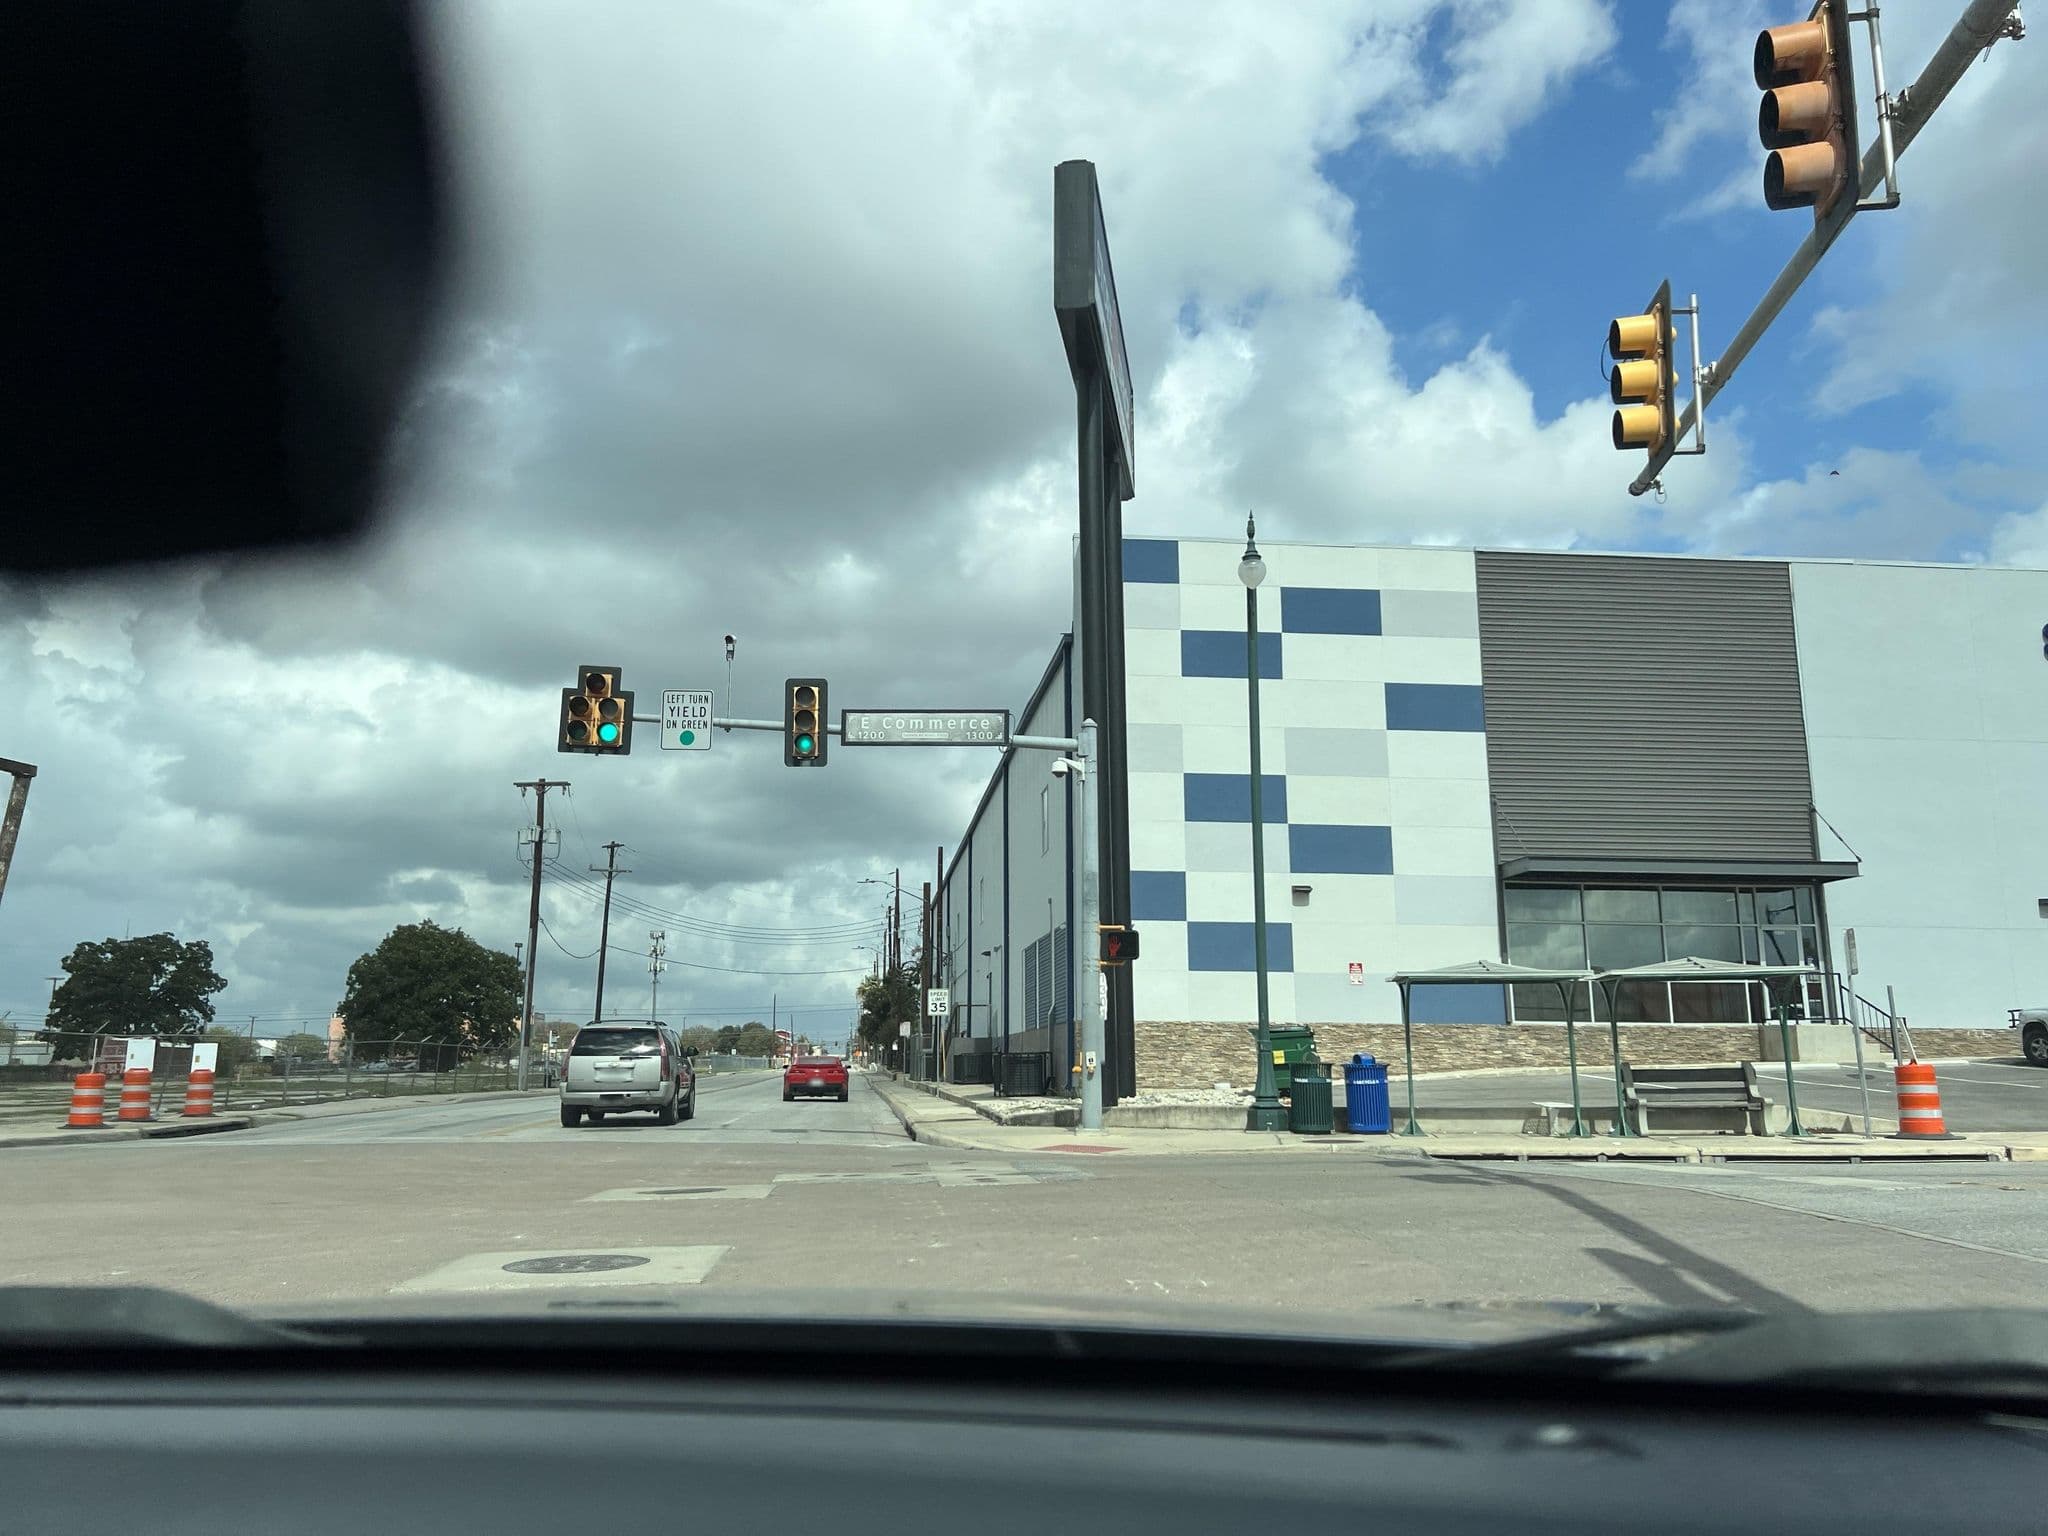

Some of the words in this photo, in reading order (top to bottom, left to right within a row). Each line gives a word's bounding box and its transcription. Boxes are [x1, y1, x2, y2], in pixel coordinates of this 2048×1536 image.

[667, 694, 685, 704] LEFT
[689, 694, 709, 704] TURN
[669, 706, 707, 718] YIELD
[666, 719, 677, 729] ON
[681, 719, 708, 730] GREEN
[861, 717, 870, 729] E
[882, 716, 991, 729] Commerce
[858, 731, 885, 740] 1200
[966, 731, 993, 740] 1300
[930, 1002, 947, 1013] 35
